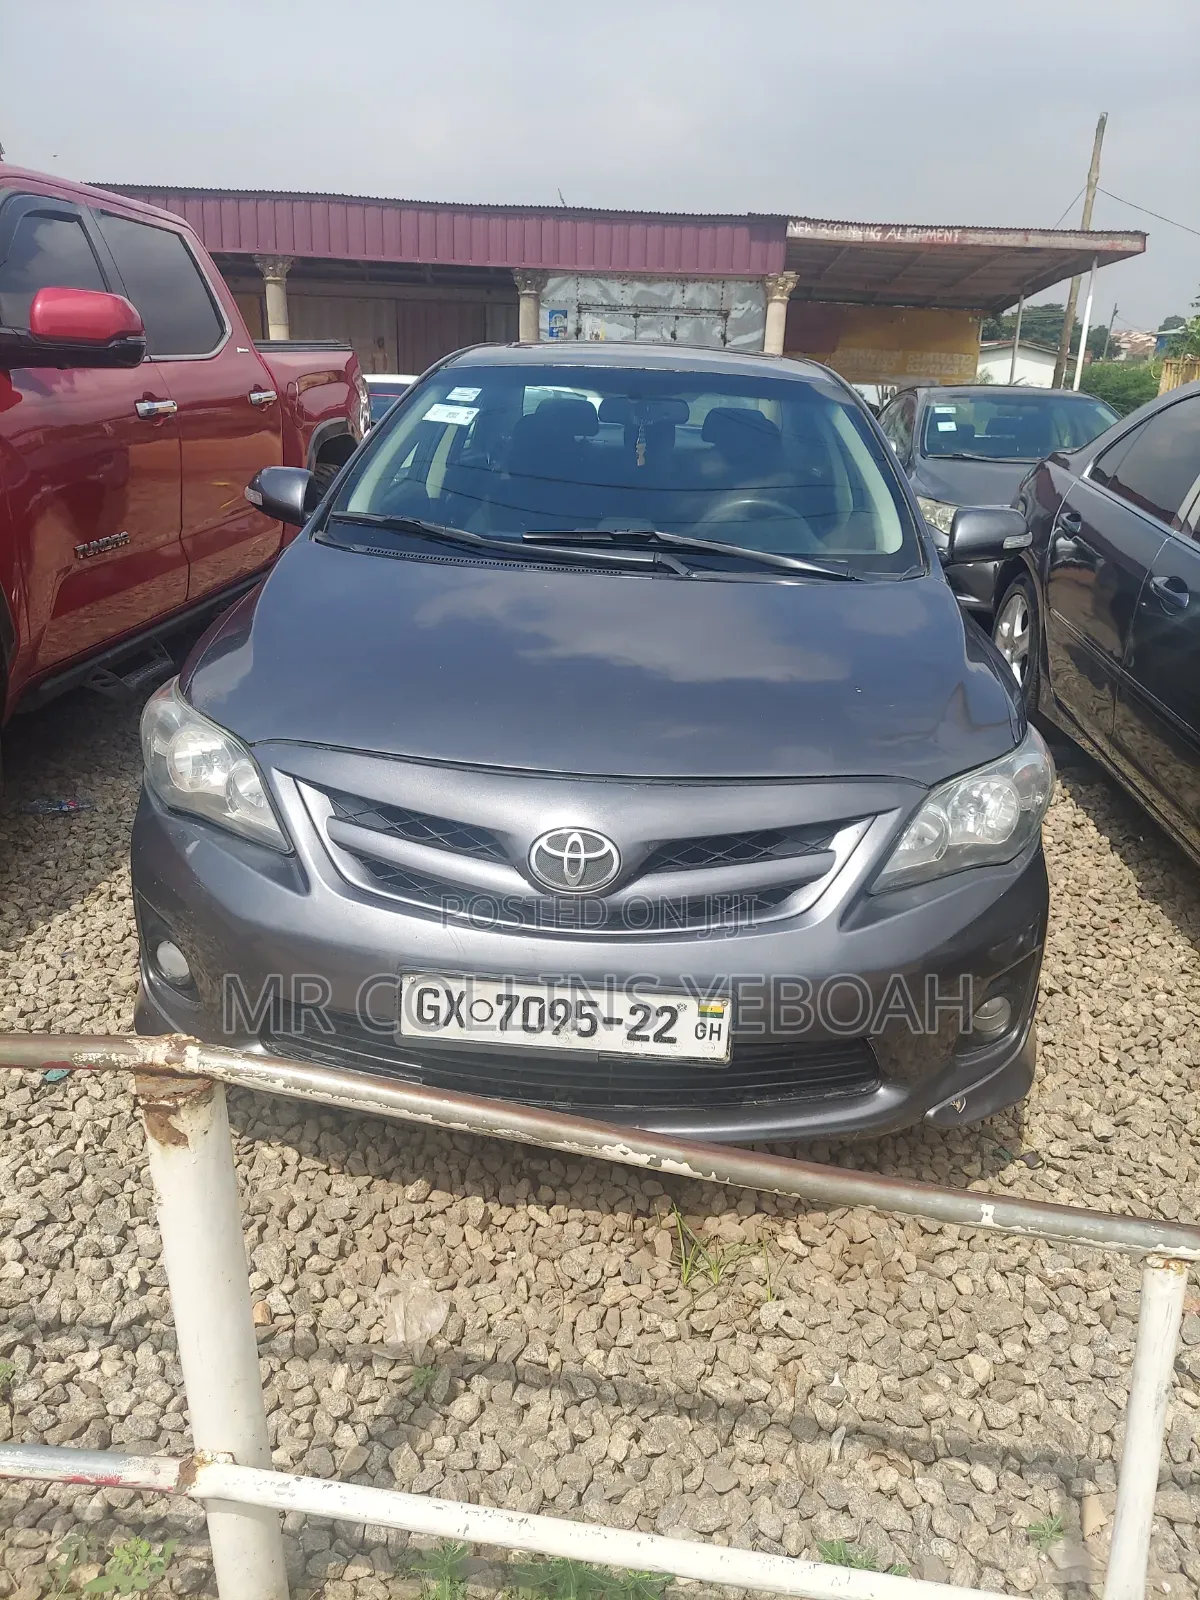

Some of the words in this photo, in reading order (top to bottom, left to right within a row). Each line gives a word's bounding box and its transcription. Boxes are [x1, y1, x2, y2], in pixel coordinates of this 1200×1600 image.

[787, 220, 815, 234] NEW
[884, 227, 963, 243] ALIGNMENT
[73, 531, 130, 560] TUNDRA
[416, 987, 467, 1029] GX
[496, 993, 679, 1045] 7095-22
[694, 1021, 722, 1042] GH
